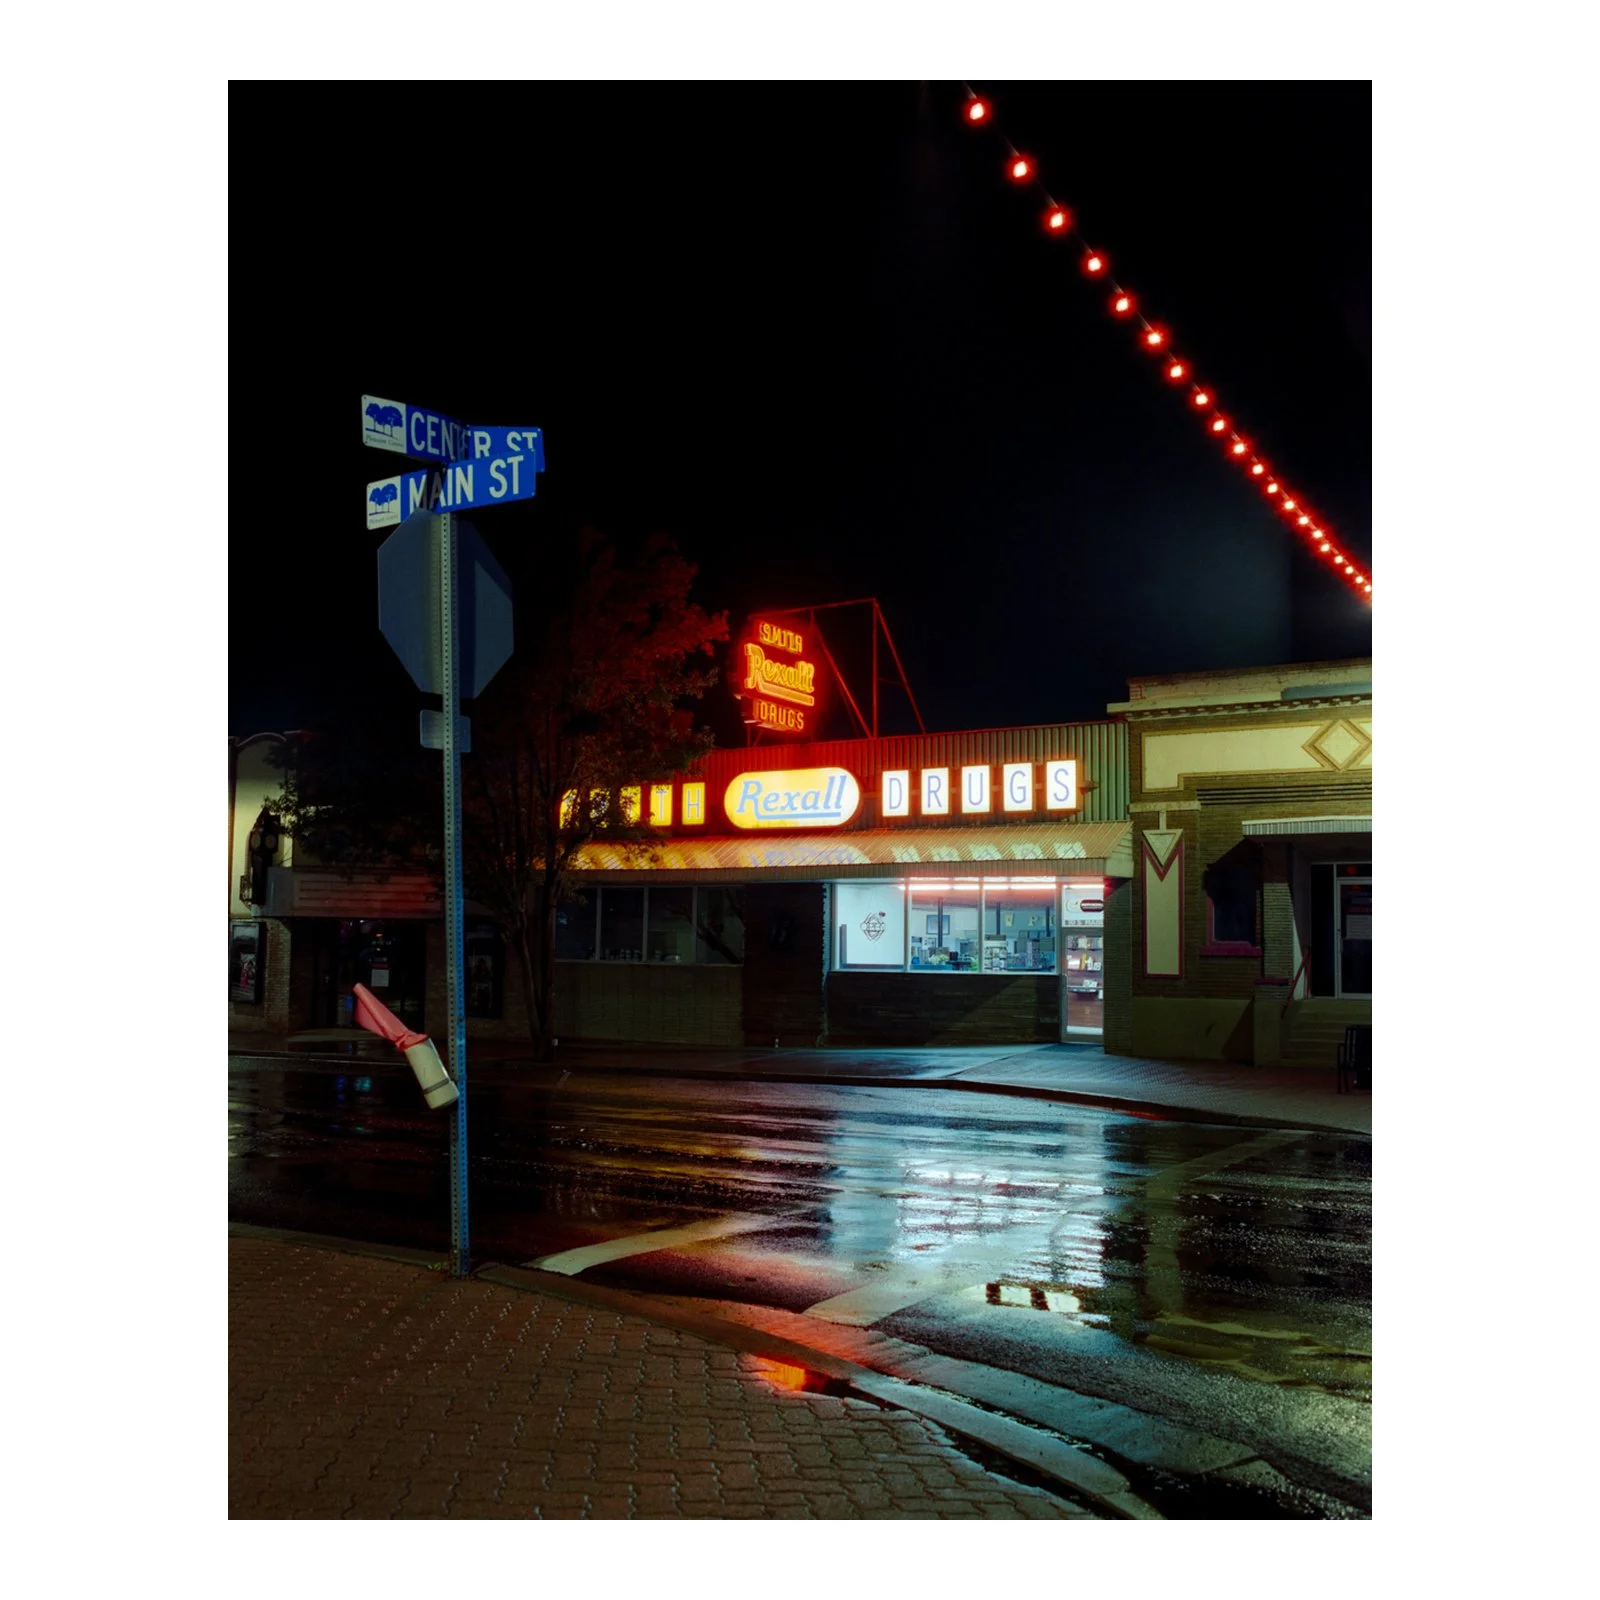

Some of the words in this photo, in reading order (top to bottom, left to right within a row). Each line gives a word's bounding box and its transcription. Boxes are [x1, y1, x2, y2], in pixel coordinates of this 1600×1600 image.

[506, 431, 538, 451] ST
[409, 464, 474, 513] MAIN
[488, 455, 524, 498] ST
[744, 642, 815, 704] Rexall
[759, 700, 804, 730] DRUGS
[736, 775, 848, 820] Rexall
[888, 767, 1070, 810] DRUGS
